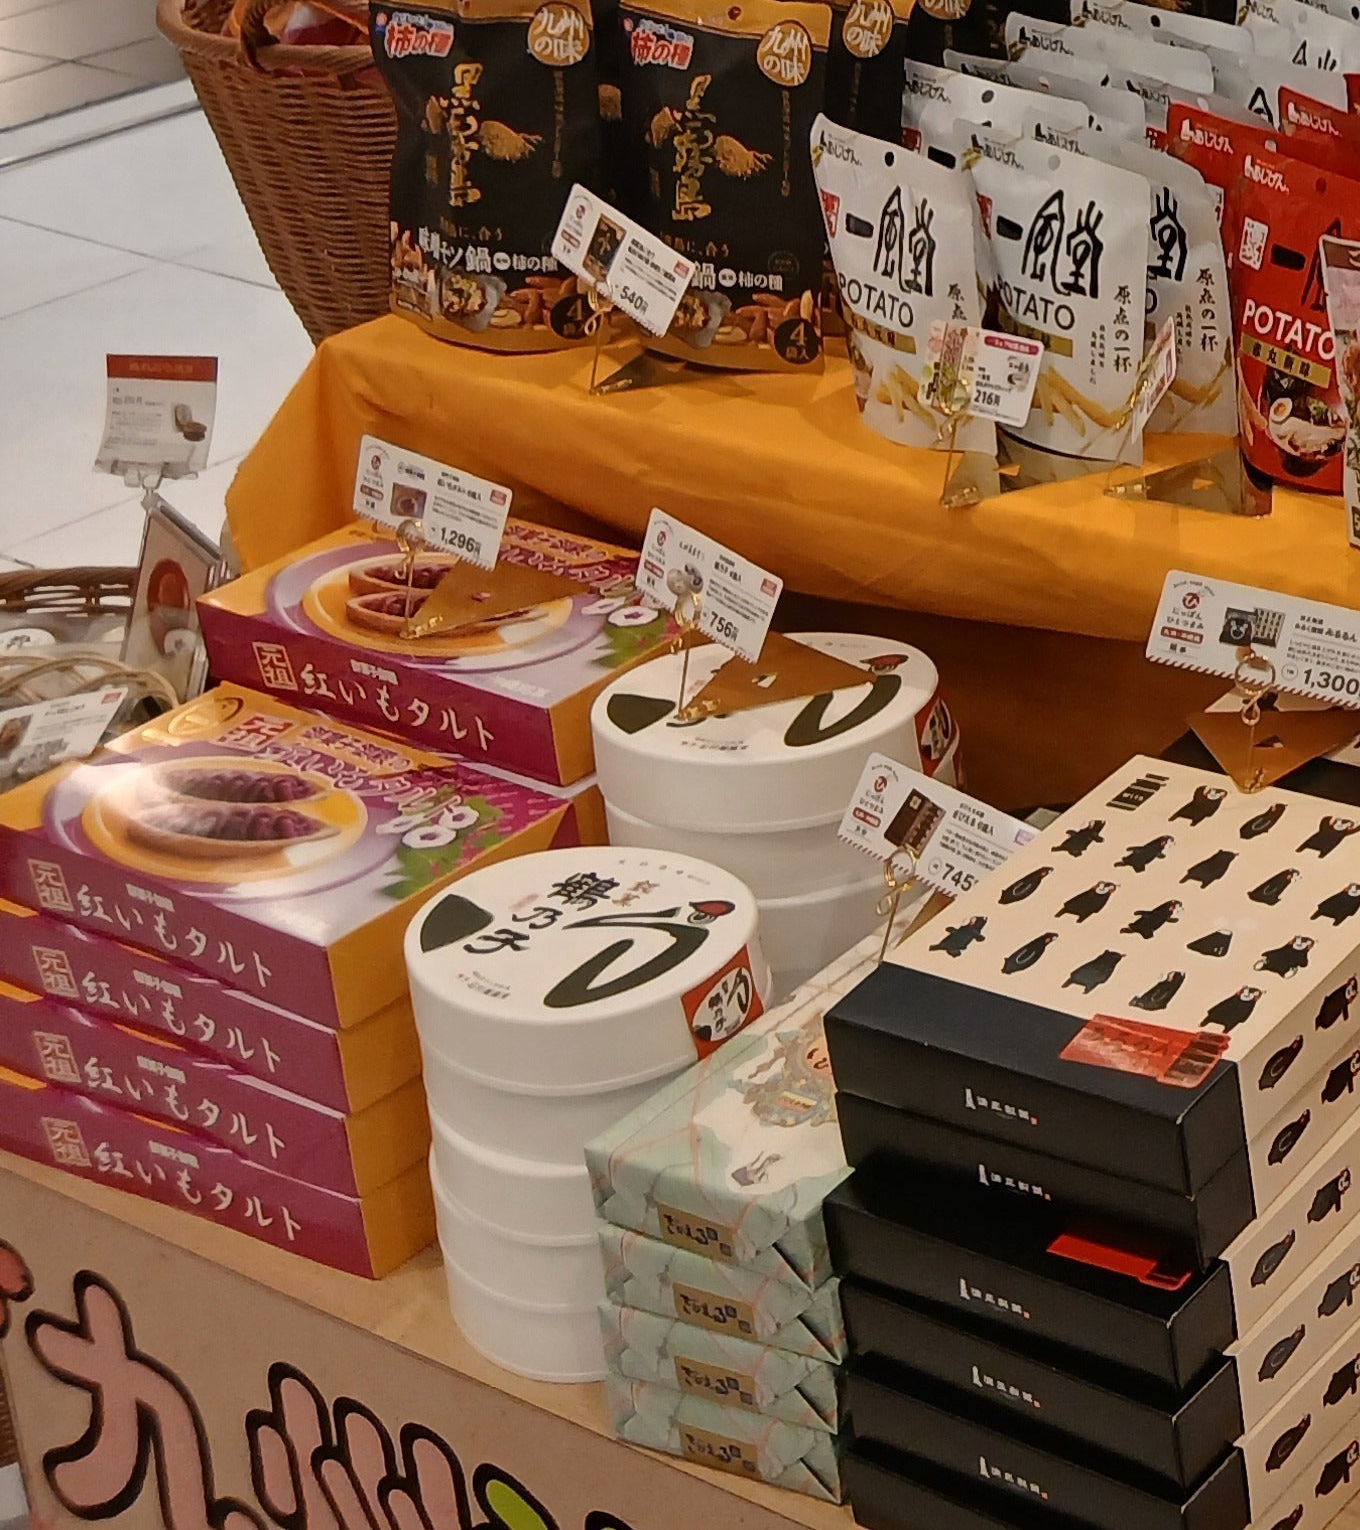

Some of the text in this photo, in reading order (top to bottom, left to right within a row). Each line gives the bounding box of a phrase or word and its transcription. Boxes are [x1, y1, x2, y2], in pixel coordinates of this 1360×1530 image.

[533, 6, 585, 39] 九州
[533, 35, 585, 64] の味
[767, 28, 809, 56] 九州
[763, 55, 808, 82] の味
[845, 185, 936, 298] 一風堂
[995, 188, 1104, 300] 一風堂
[838, 272, 915, 330] POTATO
[1241, 297, 1337, 362] POTATO
[788, 323, 806, 347] 4
[440, 526, 482, 555] 1,296円
[299, 662, 496, 752] 紅いもタルト
[76, 881, 273, 984] 紅いもタルト
[80, 967, 282, 1073] 紅いもタルト
[83, 1058, 286, 1159] 紅いもタルト
[93, 1139, 302, 1242] 紅いもタルト
